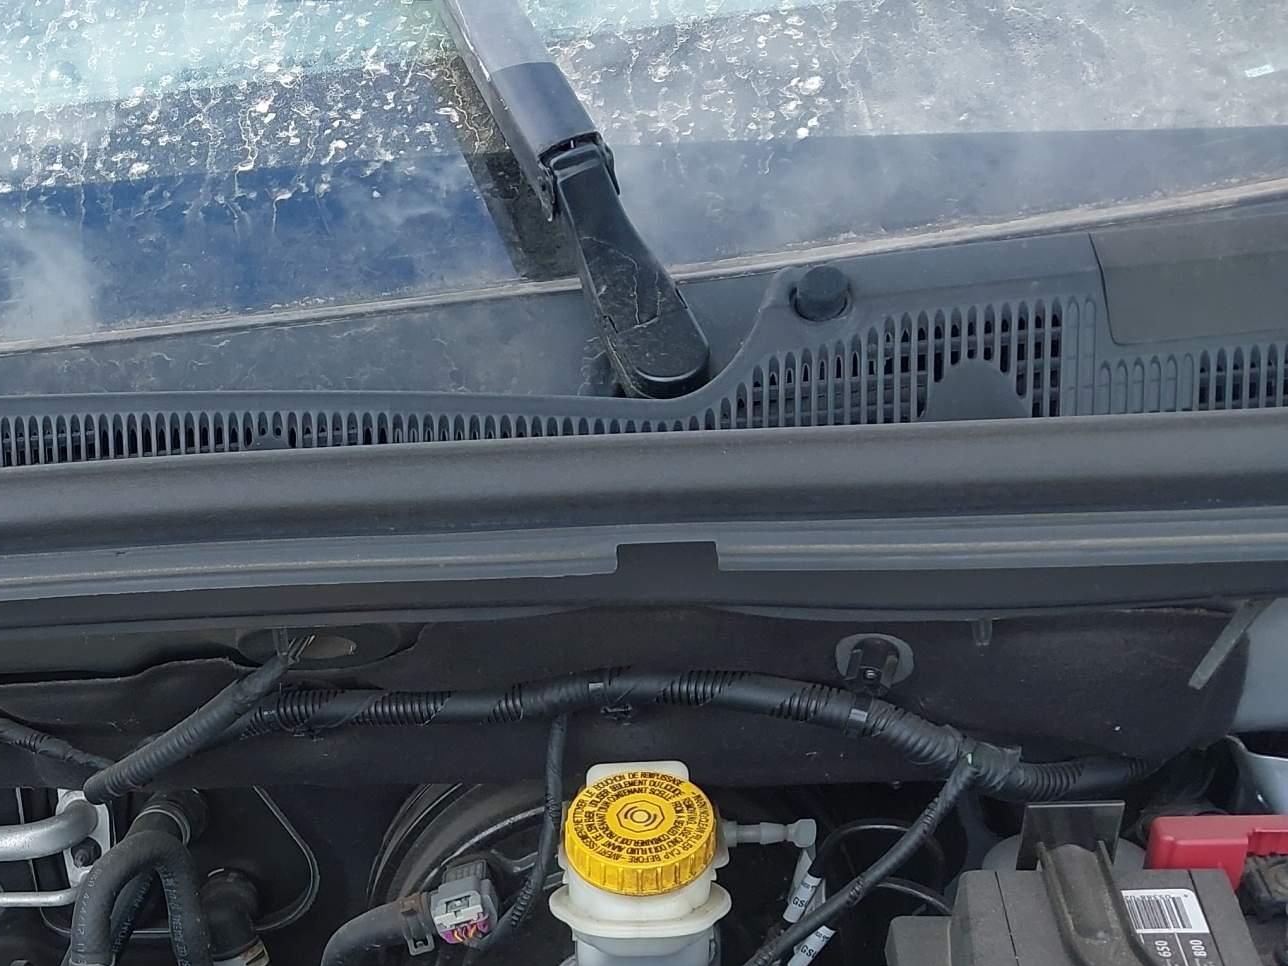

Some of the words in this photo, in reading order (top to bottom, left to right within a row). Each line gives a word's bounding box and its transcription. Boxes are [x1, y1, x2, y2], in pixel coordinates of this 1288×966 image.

[584, 790, 593, 798] LE
[594, 774, 625, 789] BOUCHON
[641, 772, 684, 786] REMPLISSAGE
[601, 840, 626, 852] AVANT
[680, 832, 703, 851] FILLER
[628, 855, 661, 863] BEFORE
[663, 849, 682, 860] CAP
[1155, 940, 1172, 957] 650
[1190, 939, 1207, 956] 800
